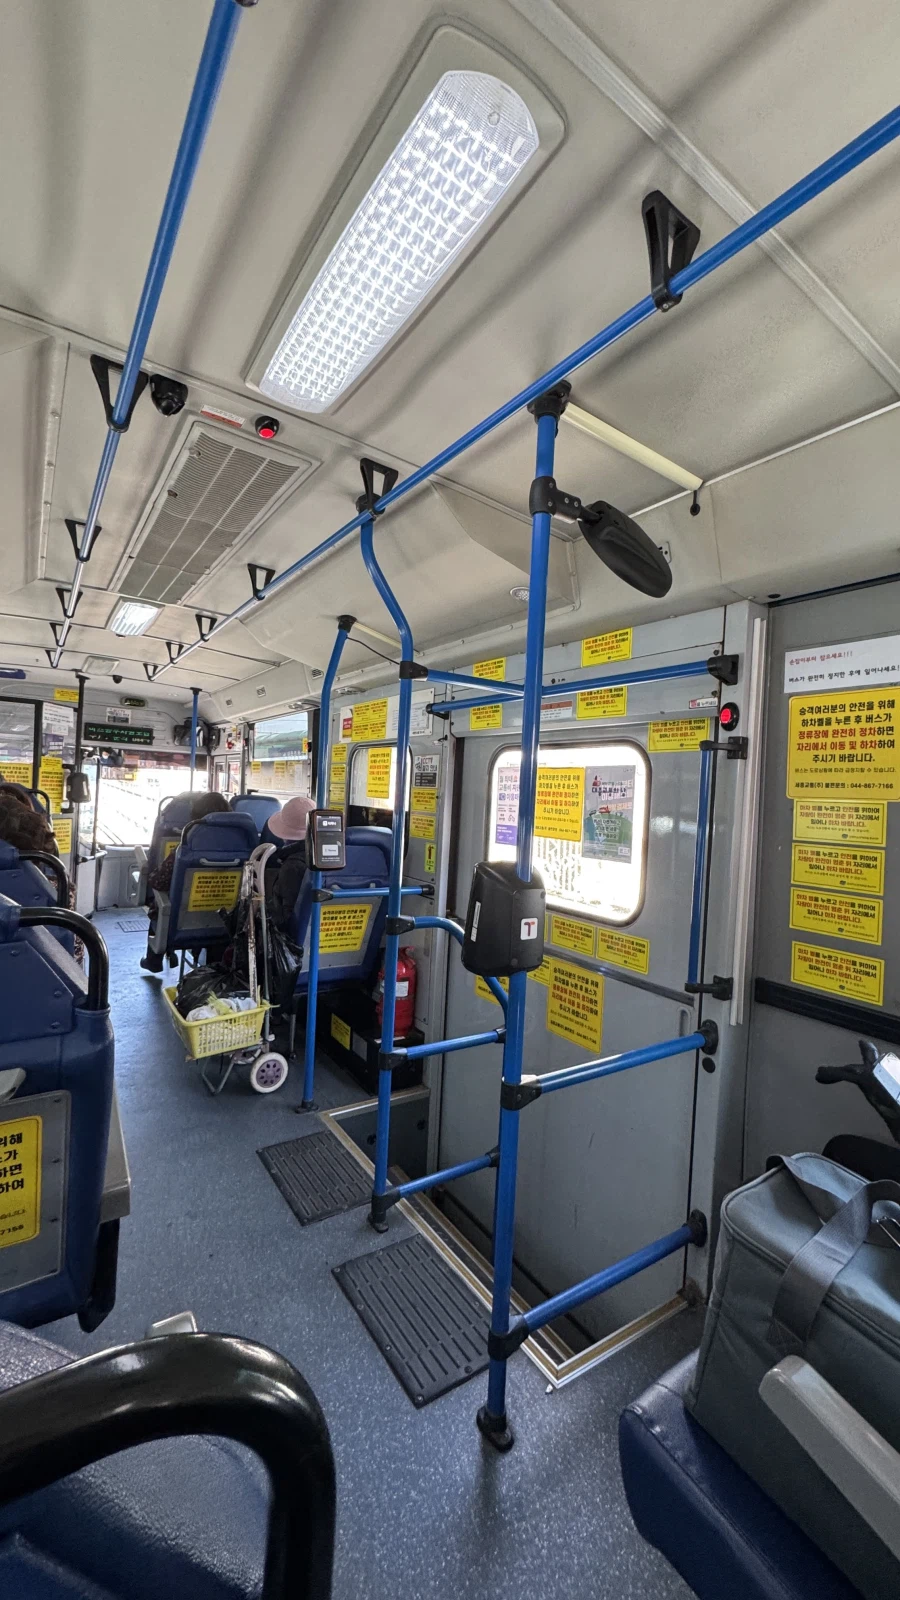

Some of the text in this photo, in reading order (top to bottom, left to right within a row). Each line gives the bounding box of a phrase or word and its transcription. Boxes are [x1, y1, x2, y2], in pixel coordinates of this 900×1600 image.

[799, 700, 895, 715] 승객여러분의 안전을 위해
[802, 713, 892, 727] 하차벨을 누른 후 버스가
[798, 726, 894, 739] 정류장에 완전히 정차하면
[797, 739, 895, 751] 자리에서 이동 및 하차하여
[813, 753, 875, 763] 주시기 바랍니다.
